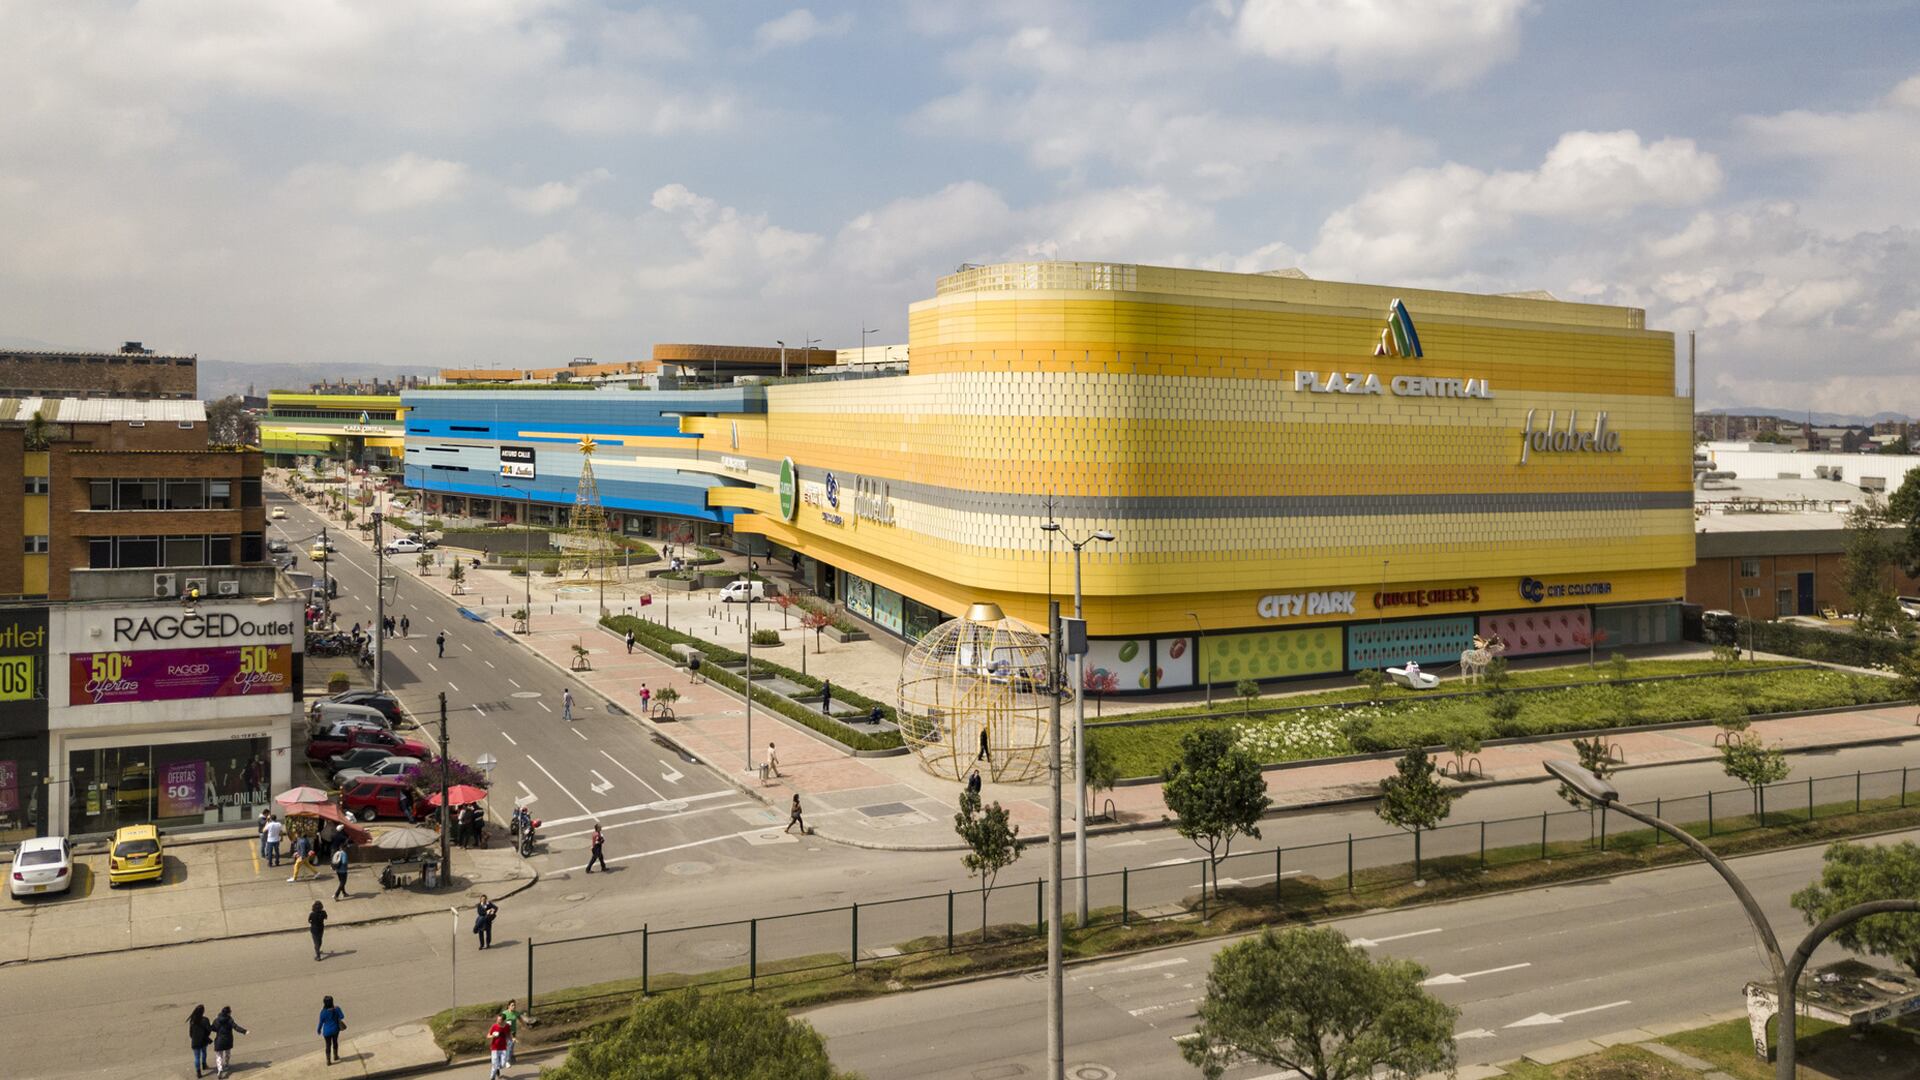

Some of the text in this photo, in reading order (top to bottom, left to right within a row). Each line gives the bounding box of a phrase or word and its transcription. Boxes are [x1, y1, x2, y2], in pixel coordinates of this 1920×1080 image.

[1295, 370, 1494, 400] PLAZA CENTRAL
[1547, 582, 1612, 597] CINE COLOMBIA
[1257, 591, 1356, 618] CITY PARK
[114, 613, 239, 642] RAGGED
[0, 662, 27, 693] OS
[92, 652, 132, 682] 50%
[168, 664, 209, 675] RAGGED
[84, 678, 138, 703] Ofertas
[234, 670, 283, 694] Ofertas
[168, 771, 196, 784] OFERTAS
[234, 791, 267, 805] ONLINE
